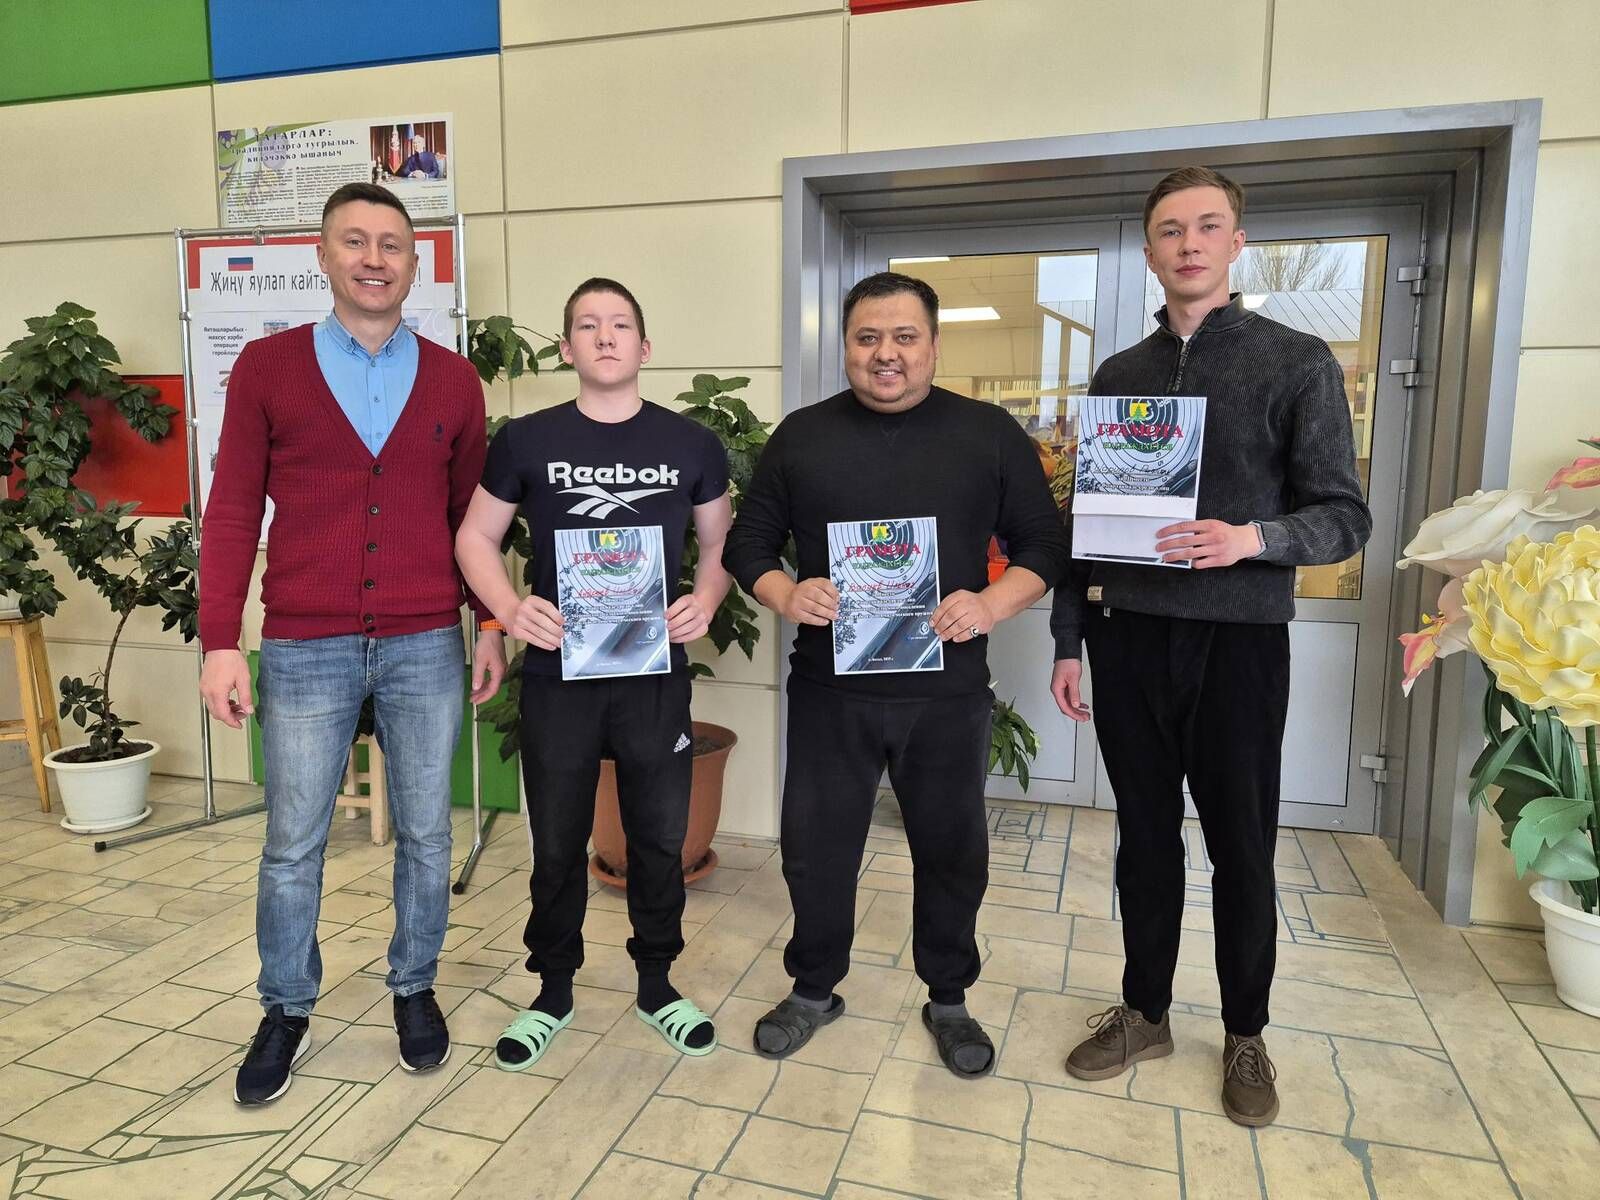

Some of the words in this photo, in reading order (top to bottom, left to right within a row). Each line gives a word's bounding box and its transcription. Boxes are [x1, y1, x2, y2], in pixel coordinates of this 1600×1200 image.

[210, 271, 244, 296] Җиңү
[249, 274, 286, 296] яулап
[291, 268, 331, 293] кайты
[1097, 424, 1183, 438] ГРАМОТА
[548, 461, 680, 488] Reebok
[845, 543, 921, 558] ГРАМОТА
